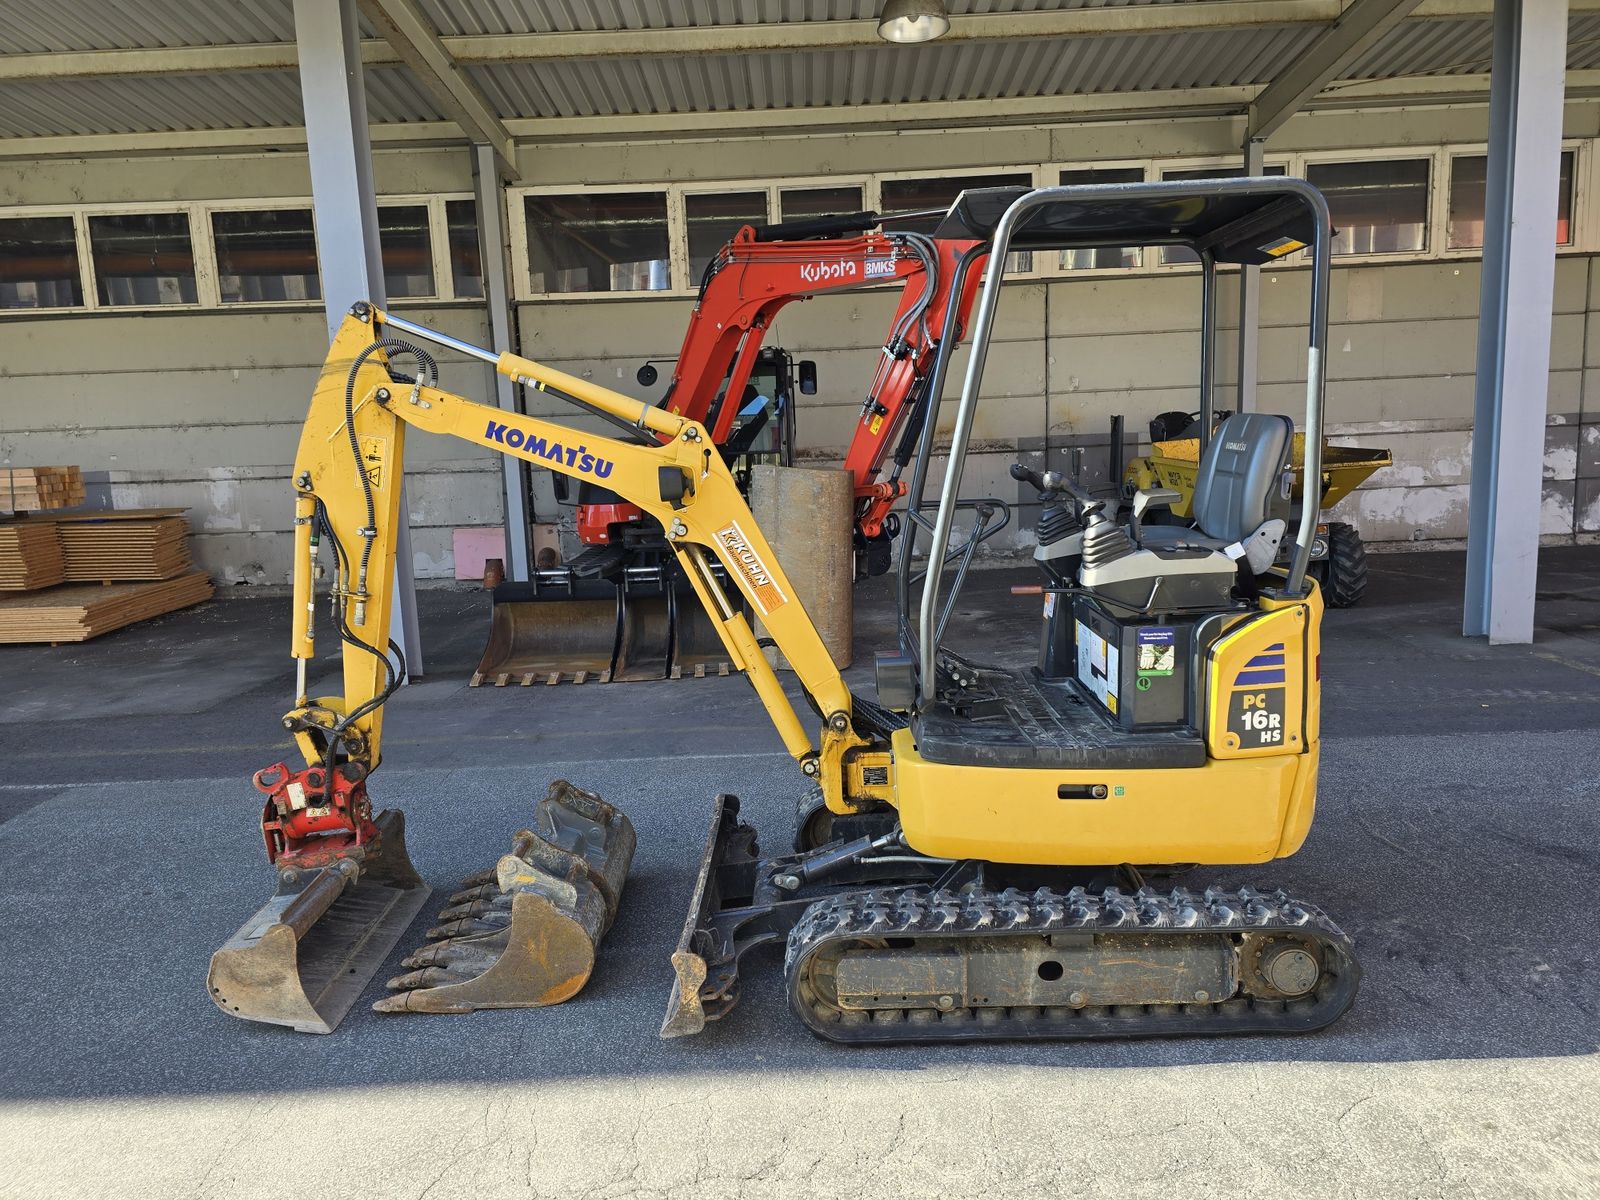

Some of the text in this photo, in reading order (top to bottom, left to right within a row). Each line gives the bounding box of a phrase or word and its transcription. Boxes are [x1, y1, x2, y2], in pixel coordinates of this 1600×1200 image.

[800, 257, 856, 282] Kubota
[865, 260, 896, 275] BMKS
[484, 420, 614, 479] KOMATSU
[726, 545, 758, 589] Baumaschinen
[734, 541, 771, 587] KUHN
[1243, 693, 1266, 710] PC
[1241, 709, 1281, 731] 16R
[1260, 729, 1281, 743] HS
